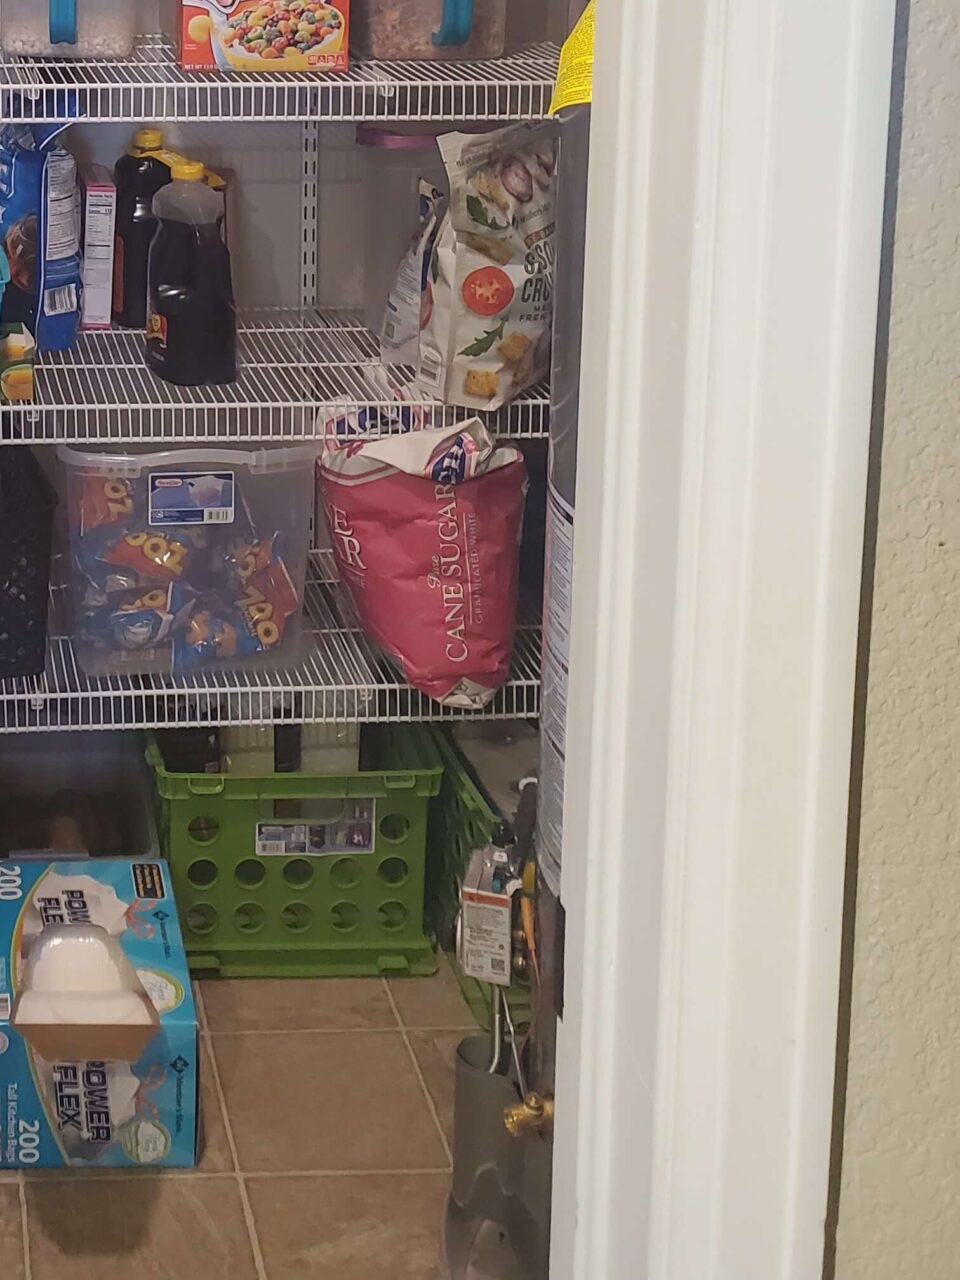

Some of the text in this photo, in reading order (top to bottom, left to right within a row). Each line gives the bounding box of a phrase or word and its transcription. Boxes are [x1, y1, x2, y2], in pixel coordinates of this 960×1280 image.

[435, 485, 469, 663] CANE SUGAR
[468, 512, 484, 624] GRANULATED WHITE
[40, 897, 64, 925] FLE
[63, 890, 91, 924] POW
[6, 1081, 18, 1163] Tall Kitchen Bags
[54, 1064, 81, 1131] FLEX
[19, 1120, 39, 1163] 200
